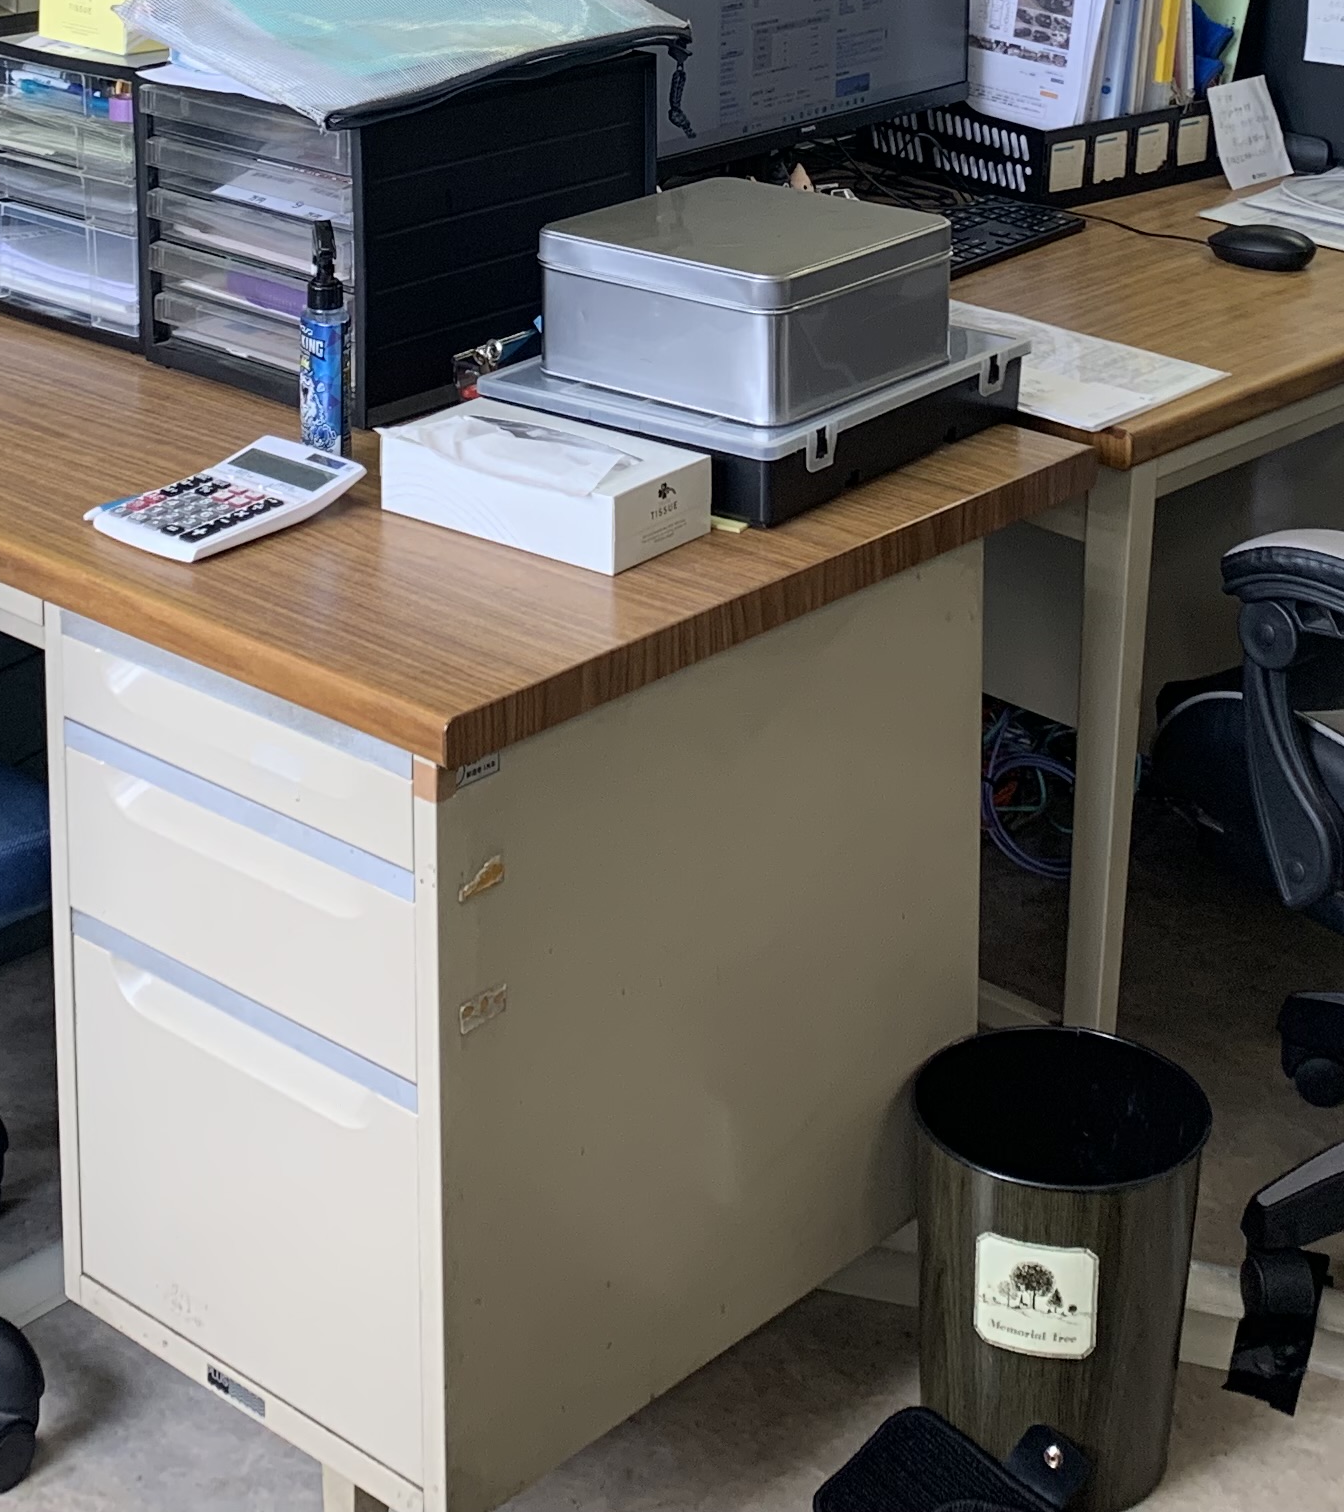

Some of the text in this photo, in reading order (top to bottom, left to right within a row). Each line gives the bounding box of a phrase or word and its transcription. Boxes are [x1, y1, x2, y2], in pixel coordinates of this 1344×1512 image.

[650, 500, 678, 520] TISSUE
[988, 1318, 1078, 1344] Memorial tree
